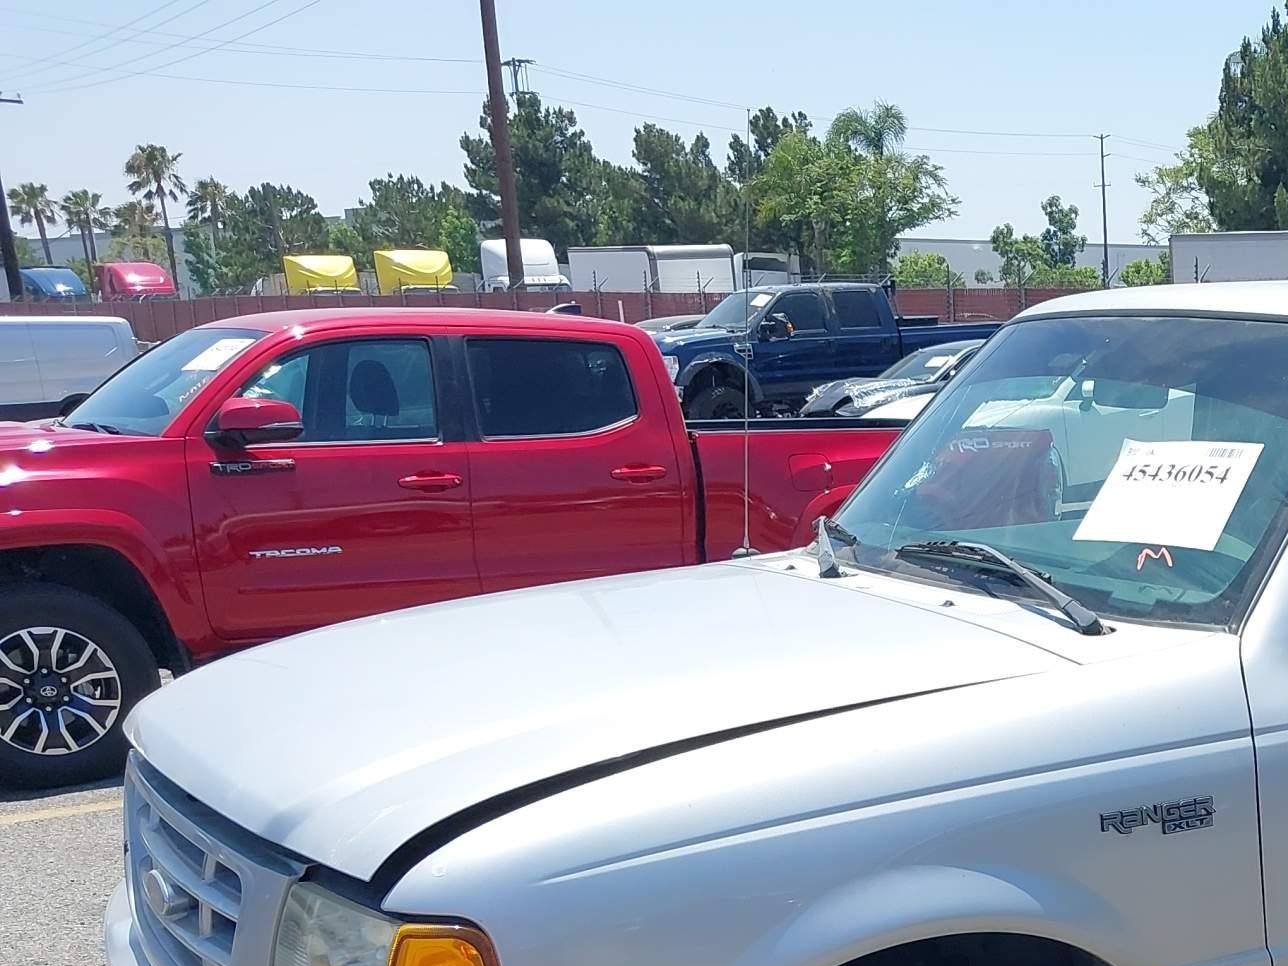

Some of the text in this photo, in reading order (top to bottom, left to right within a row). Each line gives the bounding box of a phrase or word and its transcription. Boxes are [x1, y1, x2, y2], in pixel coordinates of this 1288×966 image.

[992, 441, 1033, 449] SPORT
[1122, 464, 1232, 485] 45436054
[249, 546, 343, 559] TACOMA
[1100, 795, 1216, 834] RANGER
[1171, 817, 1209, 832] XLT
